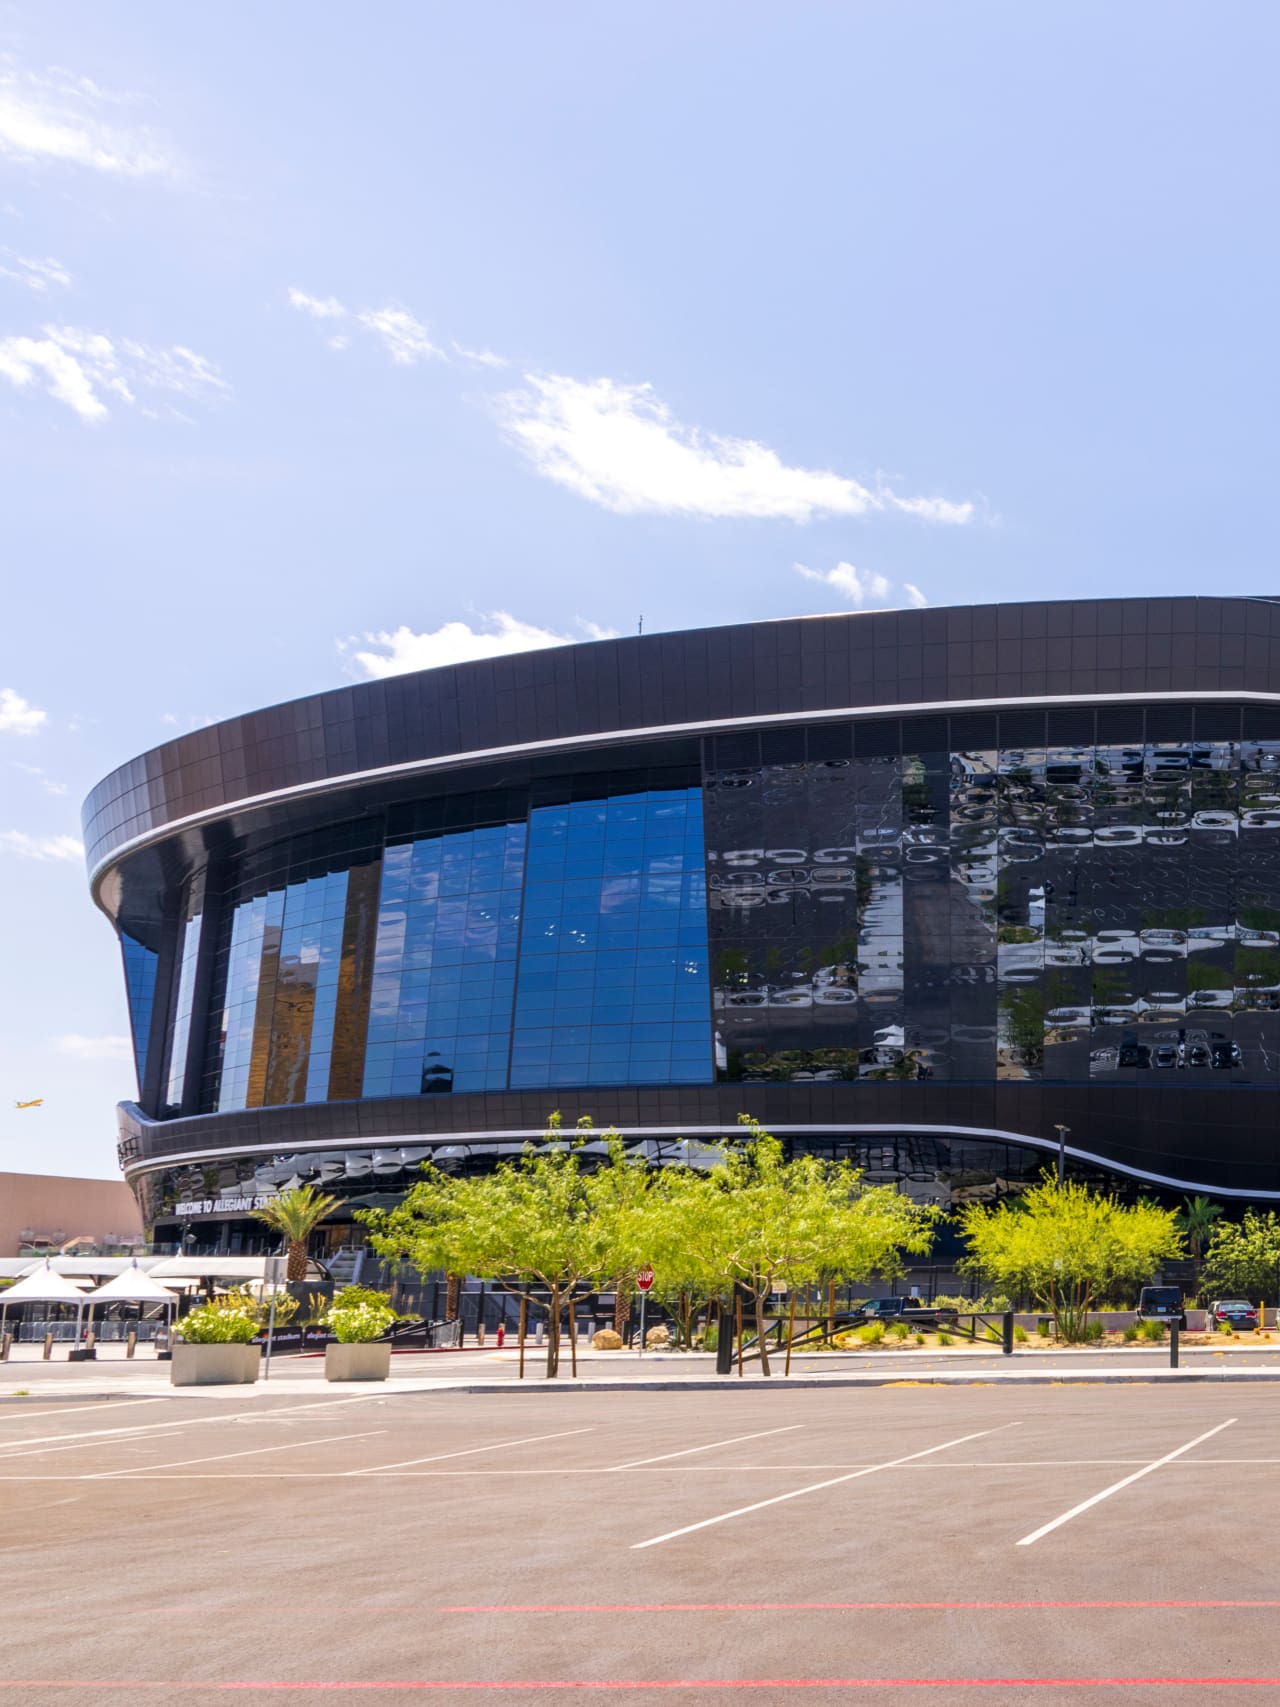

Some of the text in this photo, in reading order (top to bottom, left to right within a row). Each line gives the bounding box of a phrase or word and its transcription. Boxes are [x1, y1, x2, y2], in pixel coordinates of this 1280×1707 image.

[176, 1201, 202, 1216] WELCOME
[203, 1200, 213, 1214] TO
[213, 1198, 253, 1213] ALLEGIANT
[638, 1271, 653, 1281] STOP
